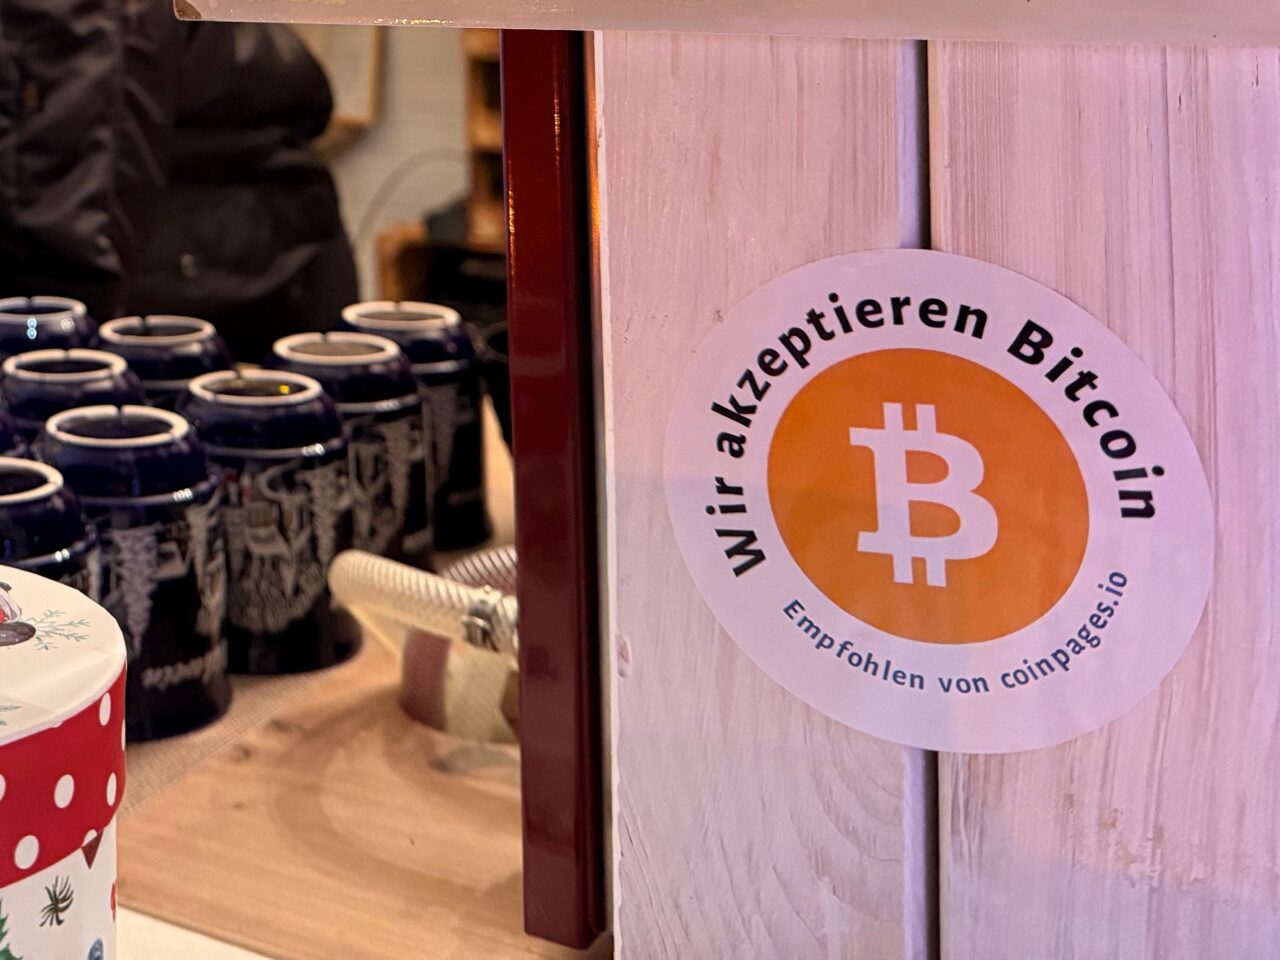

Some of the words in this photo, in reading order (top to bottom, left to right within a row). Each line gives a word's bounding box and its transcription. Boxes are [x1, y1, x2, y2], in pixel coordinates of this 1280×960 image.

[711, 292, 988, 459] akzeptieren
[1006, 319, 1165, 519] Bitcoin
[705, 476, 766, 577] Wir
[782, 599, 925, 690] Empfohlen
[938, 676, 990, 694] von
[1000, 571, 1128, 689] coinpages.io
